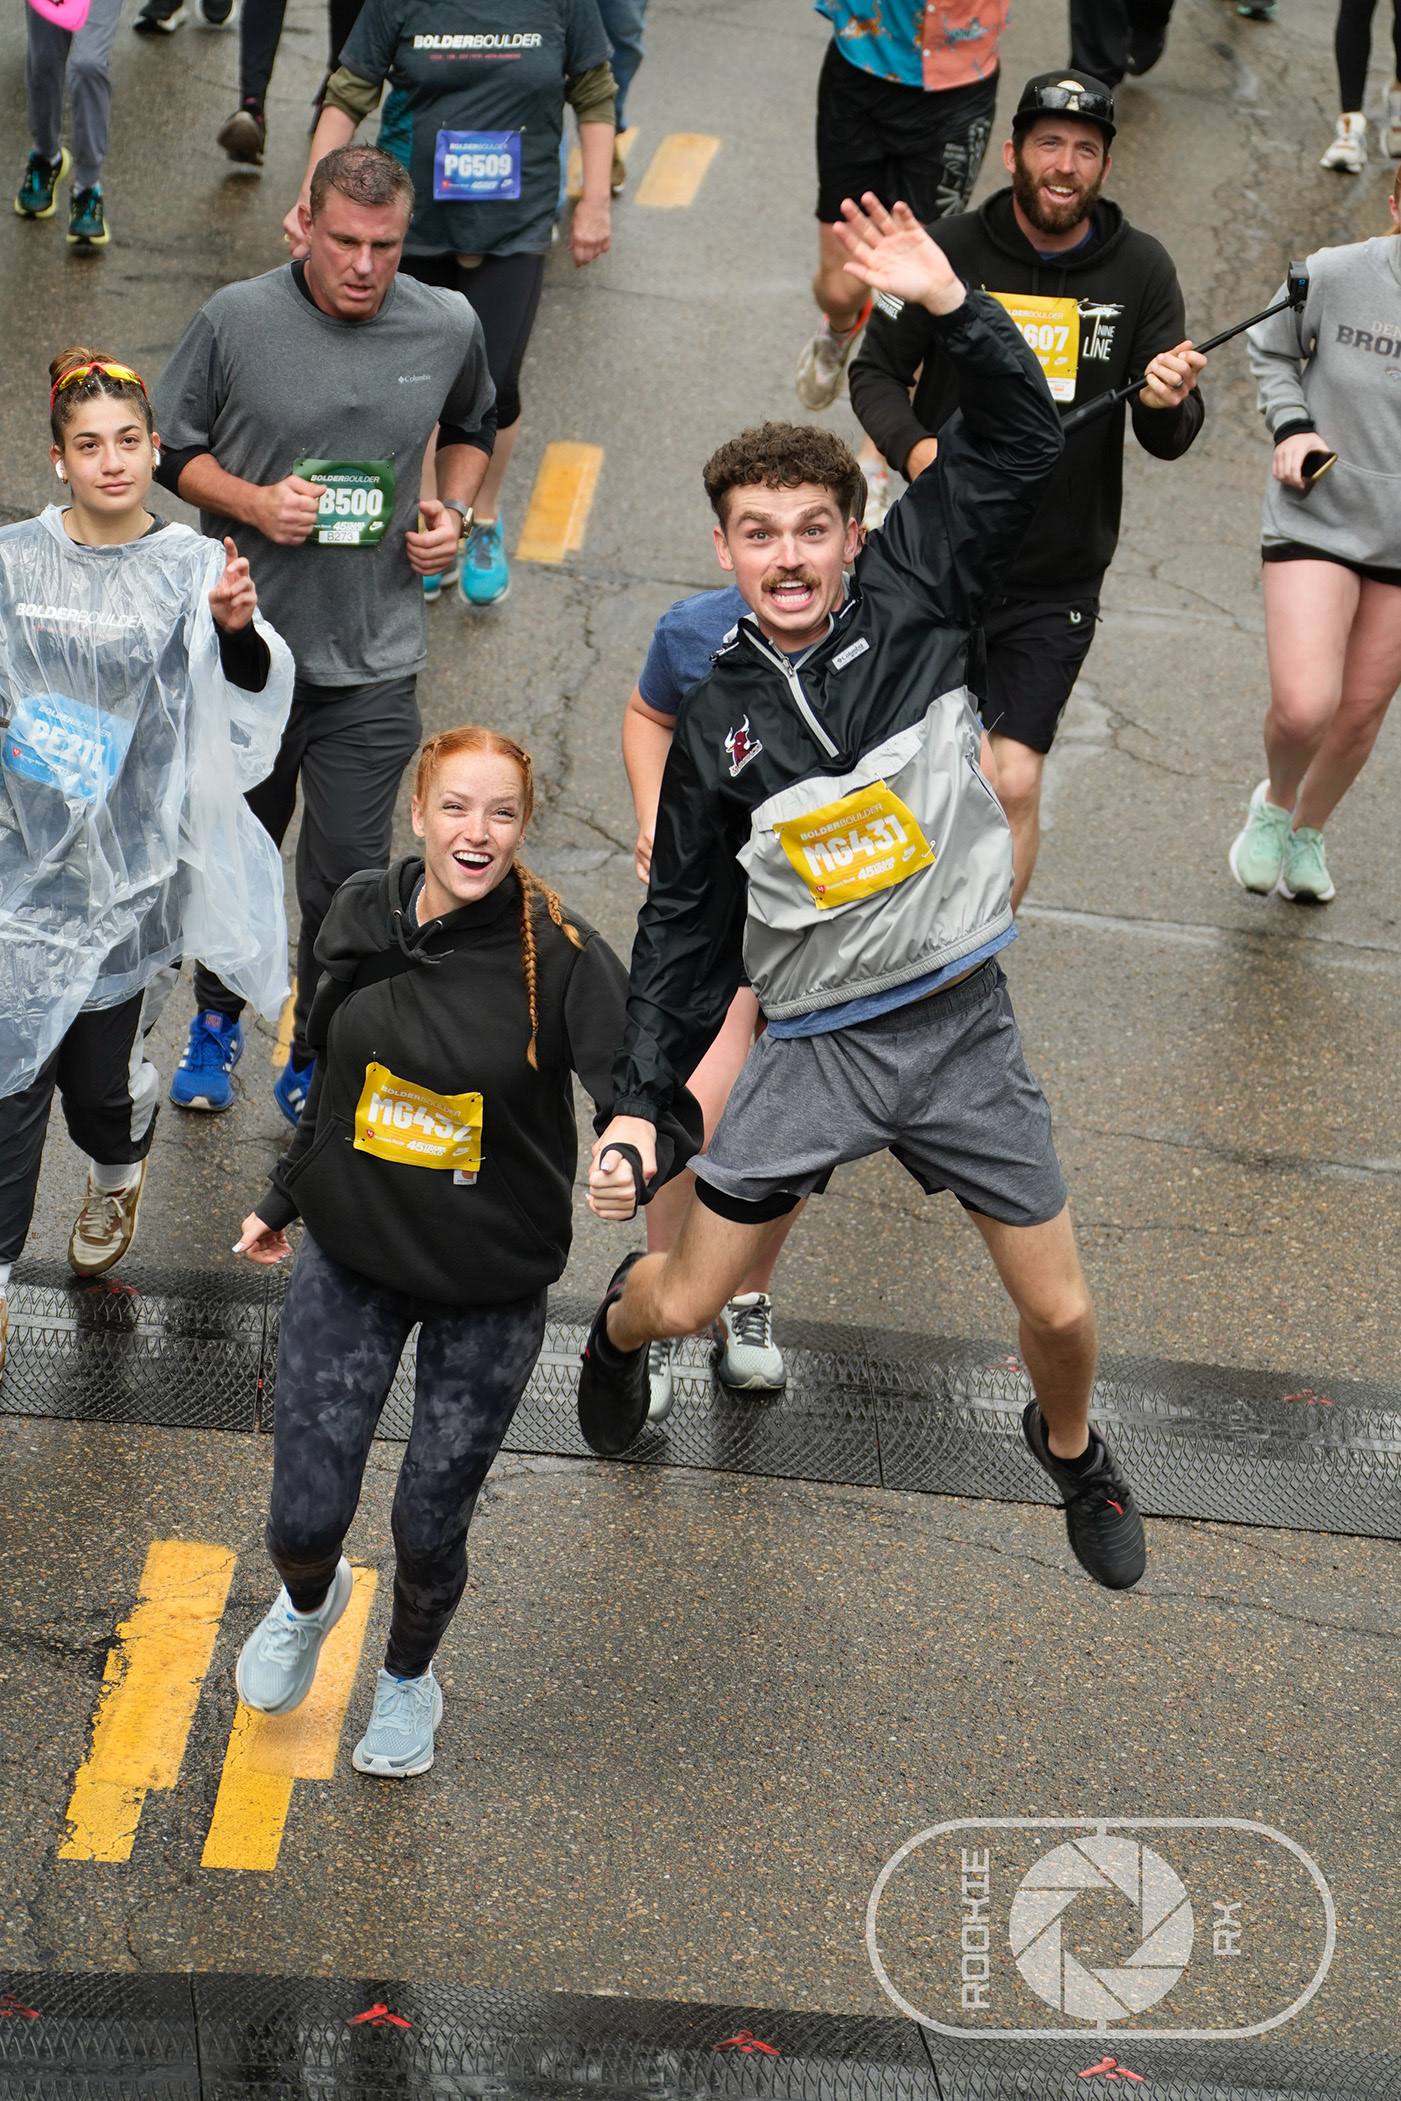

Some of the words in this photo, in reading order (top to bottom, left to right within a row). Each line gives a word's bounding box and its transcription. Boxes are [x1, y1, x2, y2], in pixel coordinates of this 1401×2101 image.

[413, 33, 542, 49] BOLDERBOULDER
[444, 153, 513, 177] PG509
[1015, 322, 1069, 352] 607
[1098, 324, 1116, 338] NINE
[1082, 336, 1113, 360] LINE
[311, 475, 380, 483] BOLDERBOULDER
[327, 531, 354, 541] B273
[16, 603, 143, 627] BOLDERBOULDER
[800, 803, 884, 840] BOLDERBOULDER
[801, 814, 908, 877] MG431
[858, 865, 875, 880] 45
[381, 1084, 461, 1117] BOLDERBOULDER
[368, 1092, 472, 1142] MG432
[406, 1140, 424, 1152] 45
